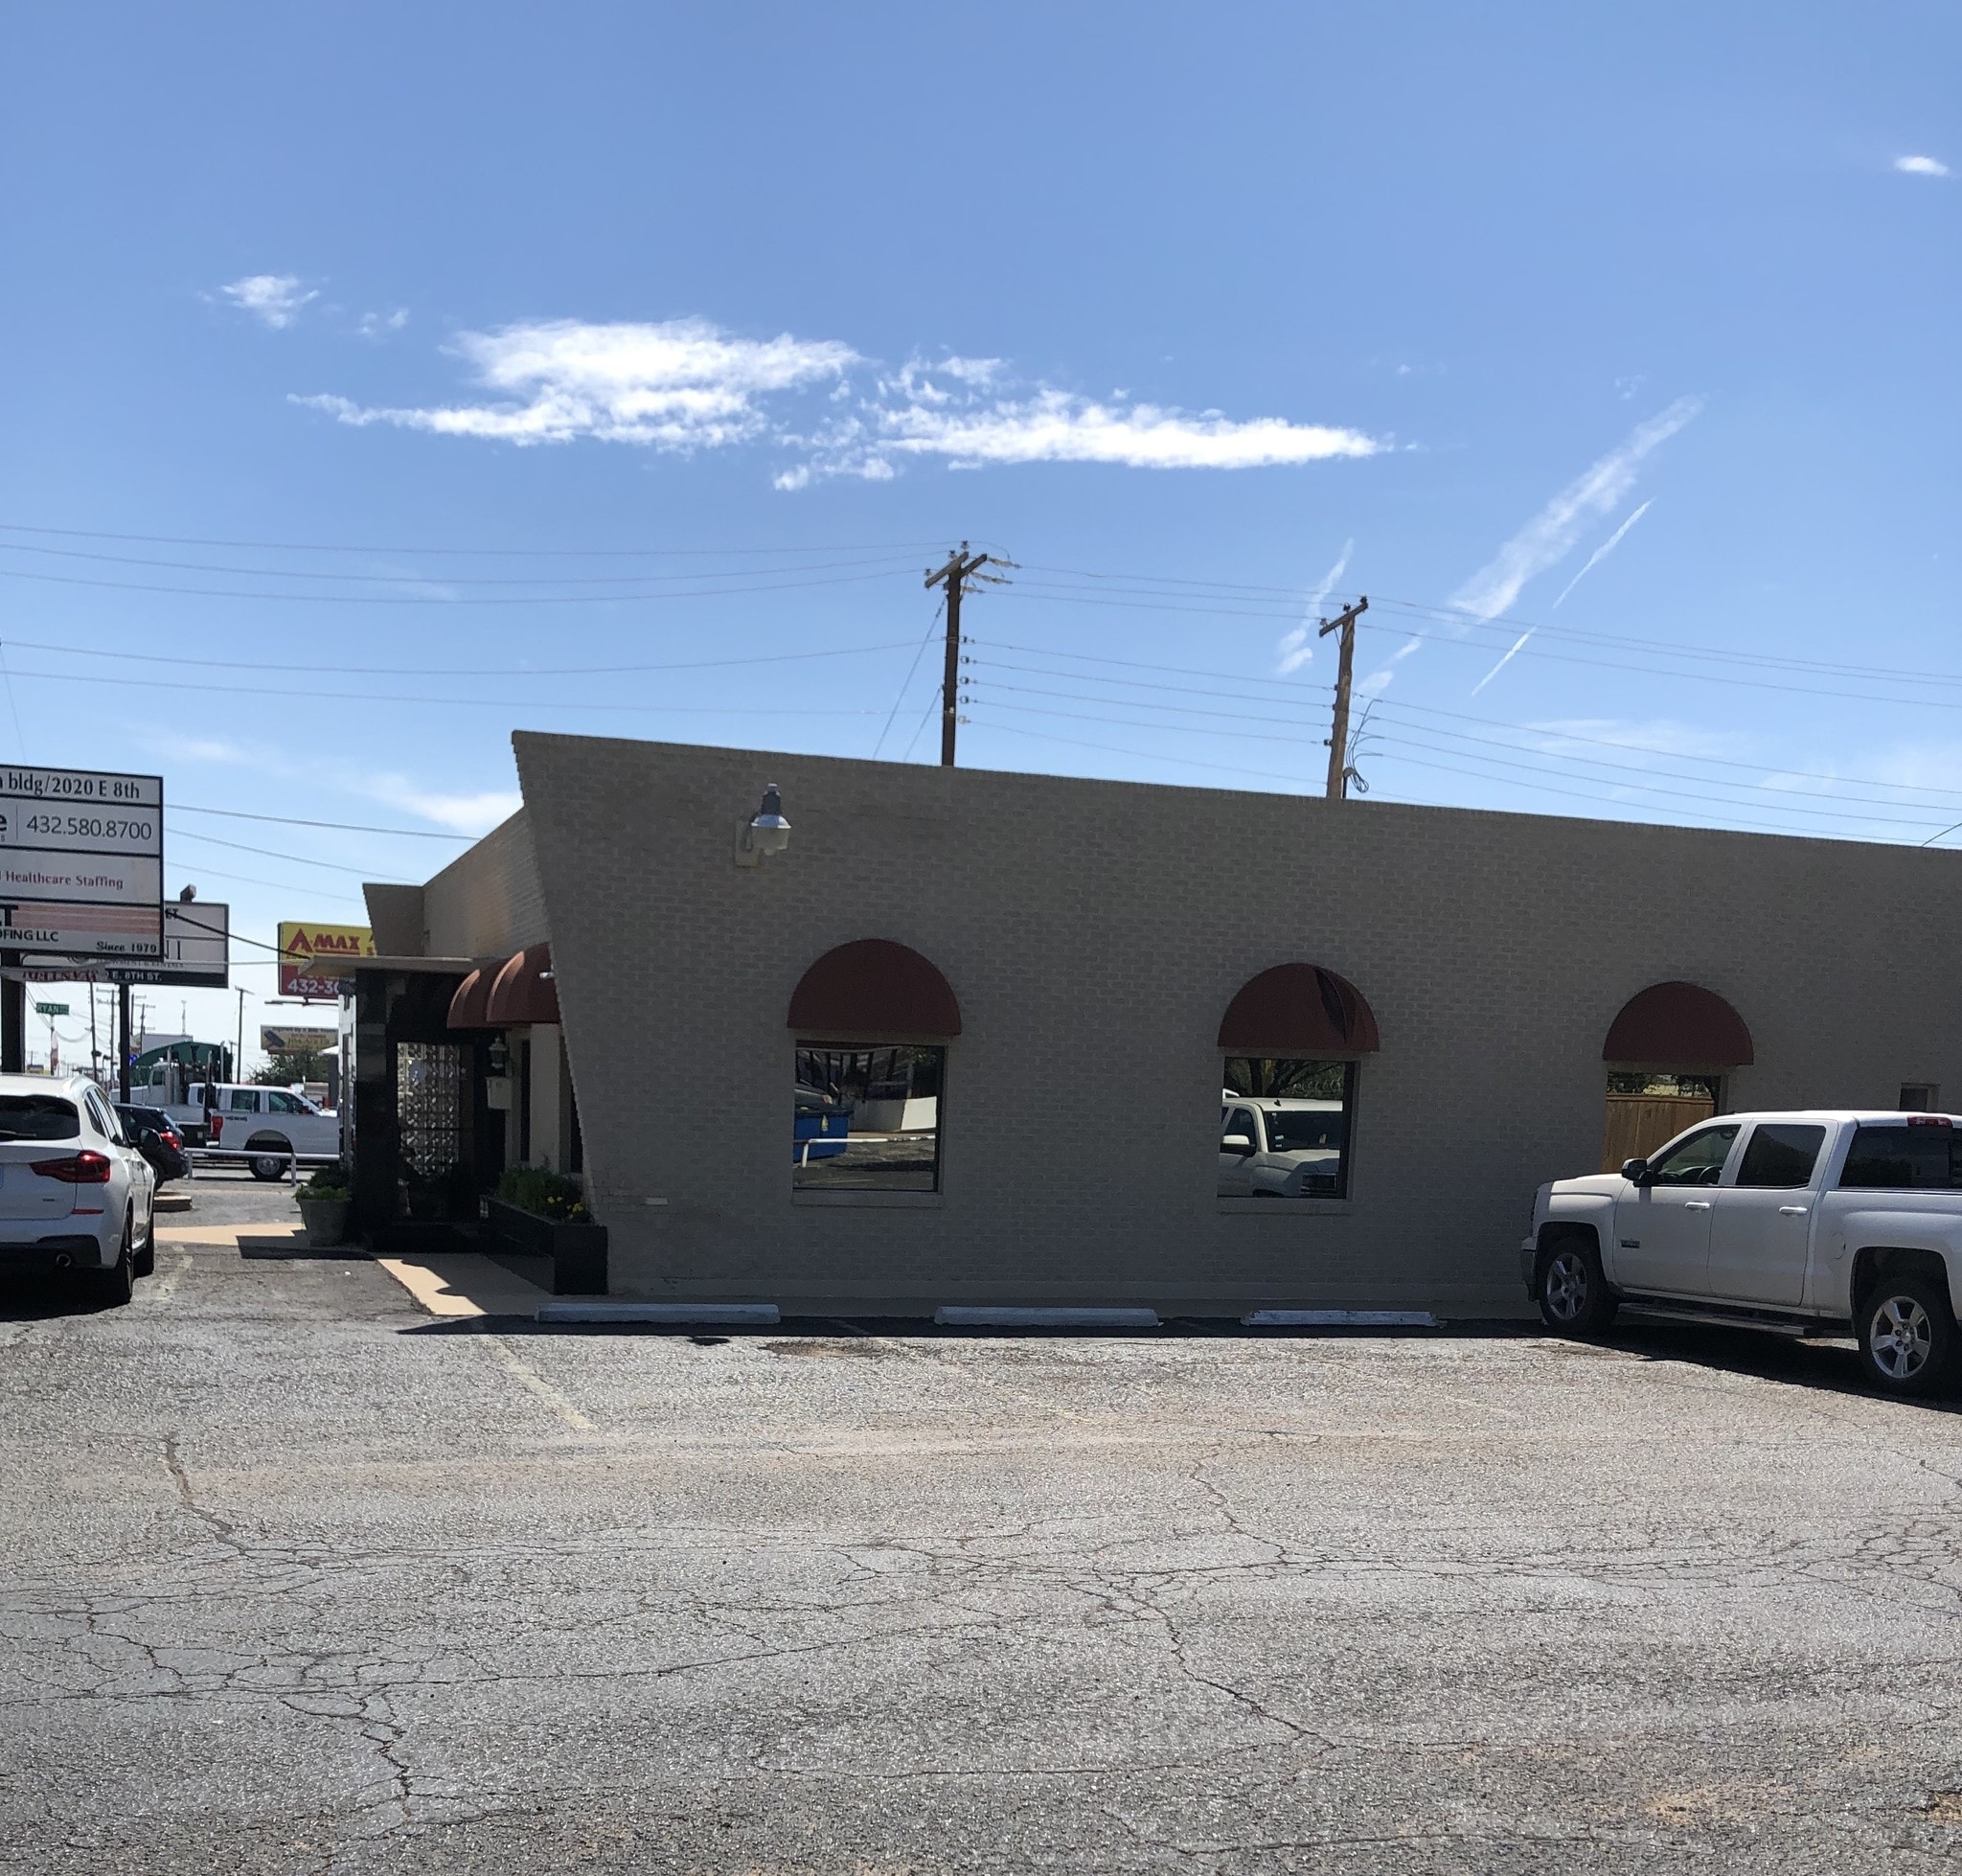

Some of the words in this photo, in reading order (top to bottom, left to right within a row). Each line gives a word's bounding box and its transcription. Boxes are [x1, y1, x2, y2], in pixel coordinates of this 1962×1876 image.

[9, 772, 93, 797] bldg/2020
[99, 780, 107, 797] E
[113, 781, 140, 799] 8th
[26, 814, 152, 840] 432.580.8700
[6, 870, 72, 885] Healthcare
[76, 875, 124, 890] Staffing
[0, 927, 34, 941] FING
[35, 930, 59, 943] LLC
[97, 941, 125, 951] Since
[131, 943, 157, 953] 1979
